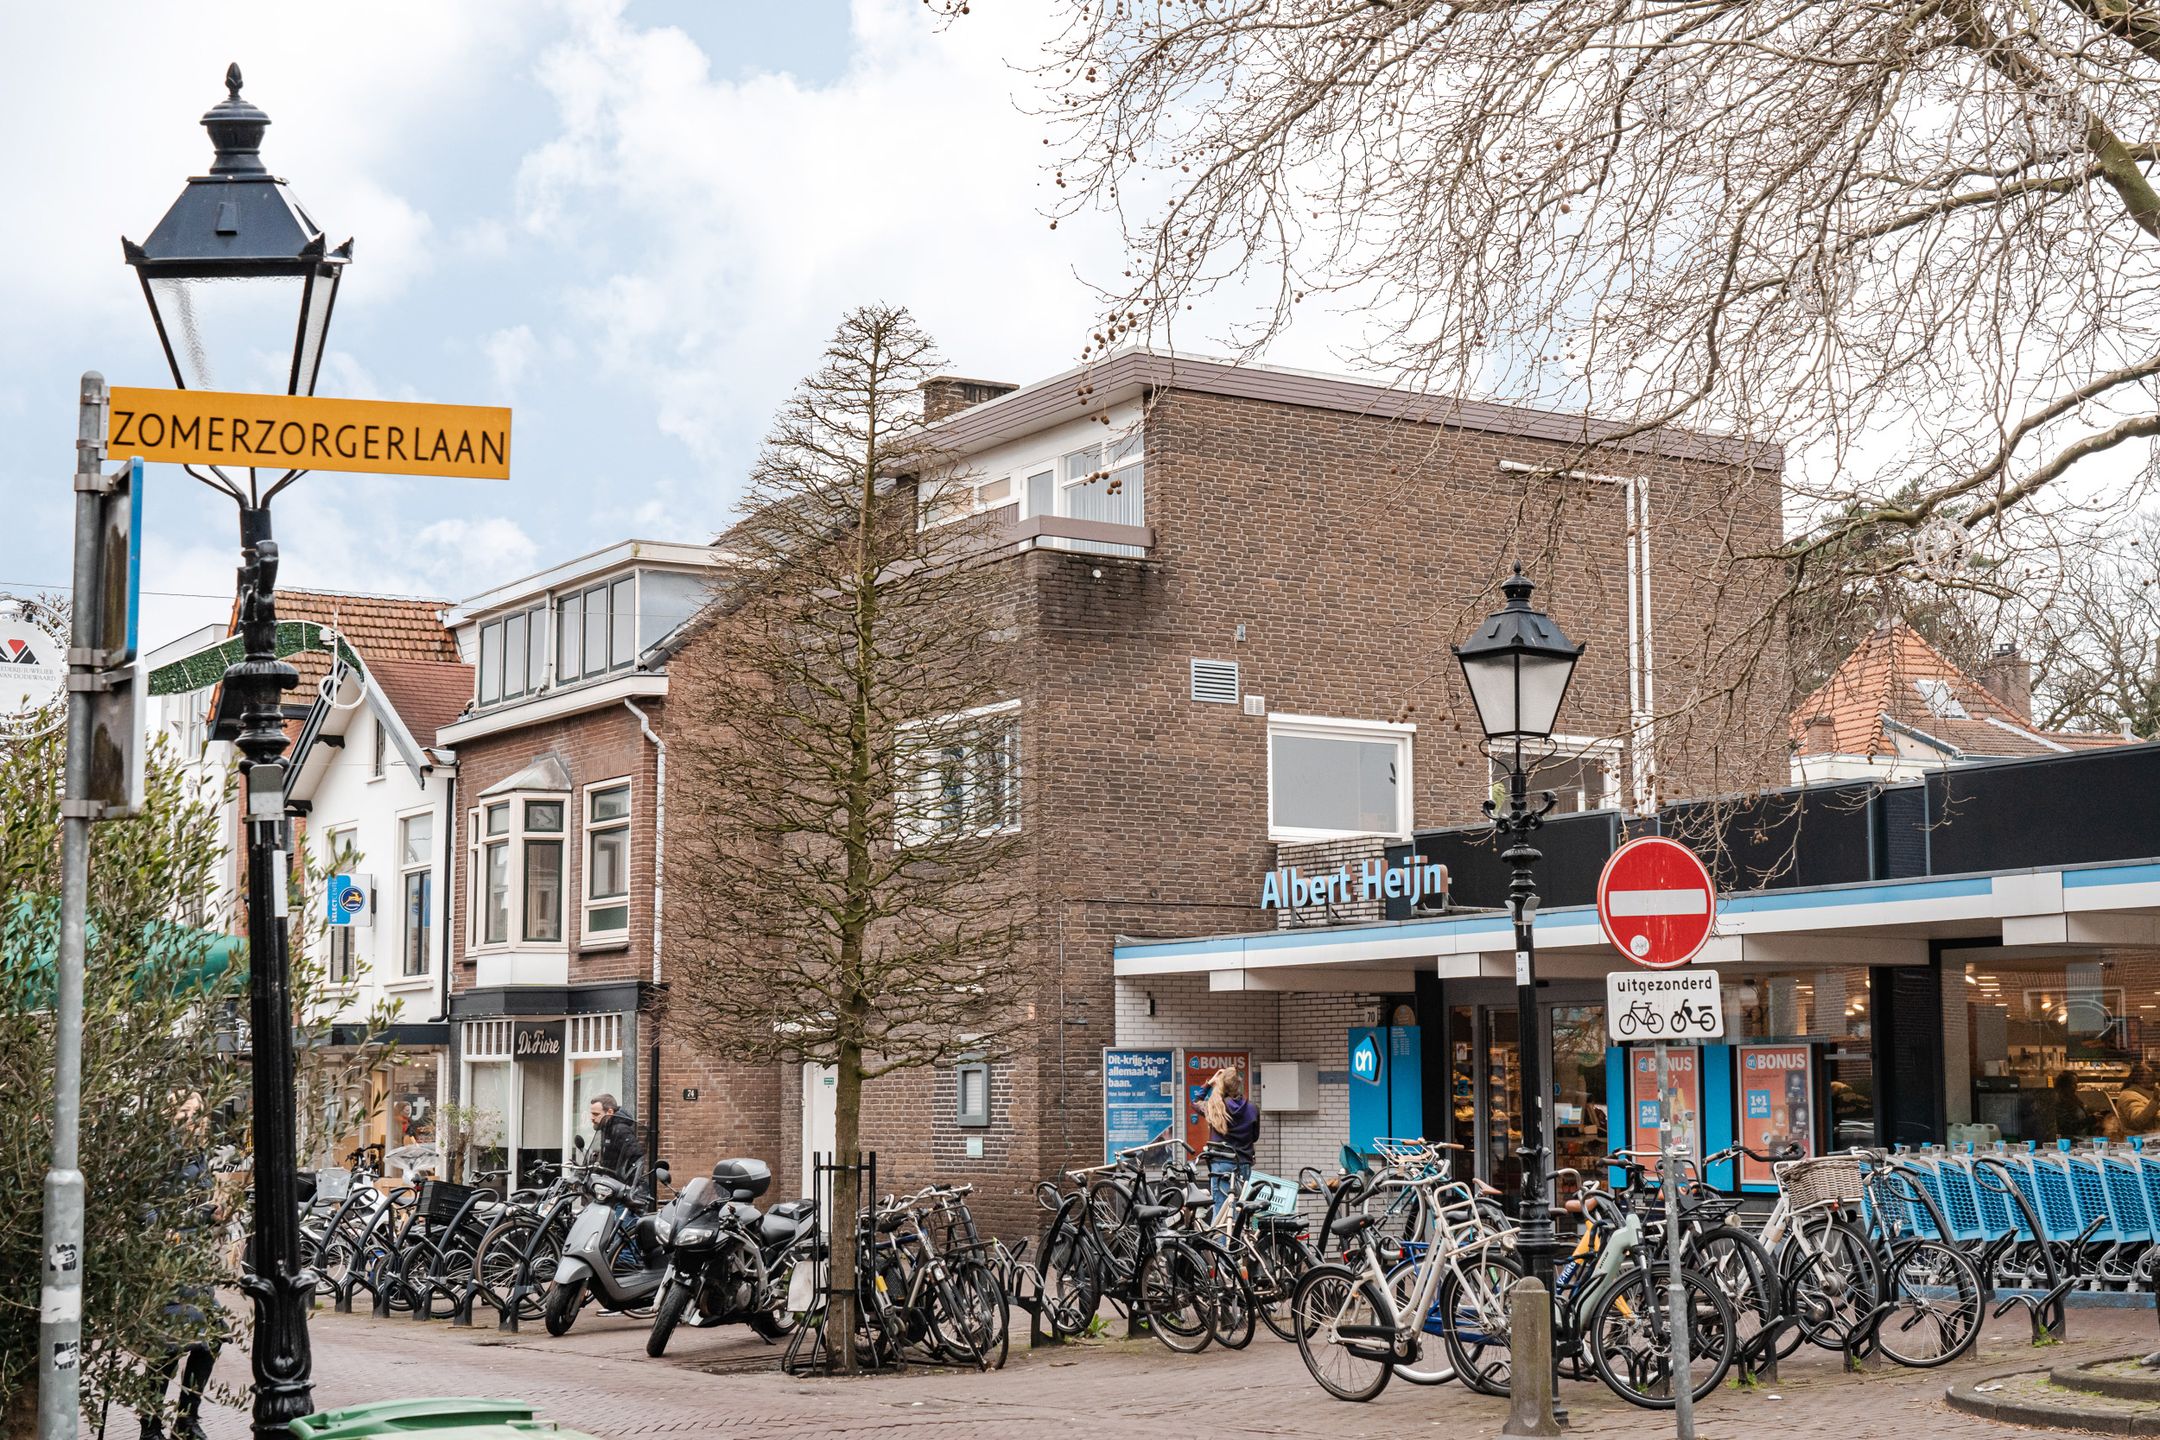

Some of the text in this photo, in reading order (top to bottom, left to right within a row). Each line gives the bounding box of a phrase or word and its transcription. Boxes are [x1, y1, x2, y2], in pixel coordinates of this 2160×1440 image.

[112, 411, 505, 465] ZOMERZORGERLAAN
[1261, 856, 1446, 910] Albert Heijn
[1617, 976, 1712, 995] uitgezonderd
[1367, 1011, 1376, 1022] 70
[1108, 1055, 1169, 1067] Dit-krijg-je-er-
[1648, 1056, 1693, 1072] BNUS
[1757, 1054, 1806, 1070] BONUS
[1108, 1067, 1162, 1077] allemaal-bij-
[1108, 1078, 1132, 1088] baan.
[687, 1089, 695, 1098] 74
[1750, 1095, 1768, 1106] 1+1
[1641, 1105, 1658, 1116] 2+1
[1751, 1106, 1768, 1115] gratis
[1642, 1117, 1658, 1125] gratis
